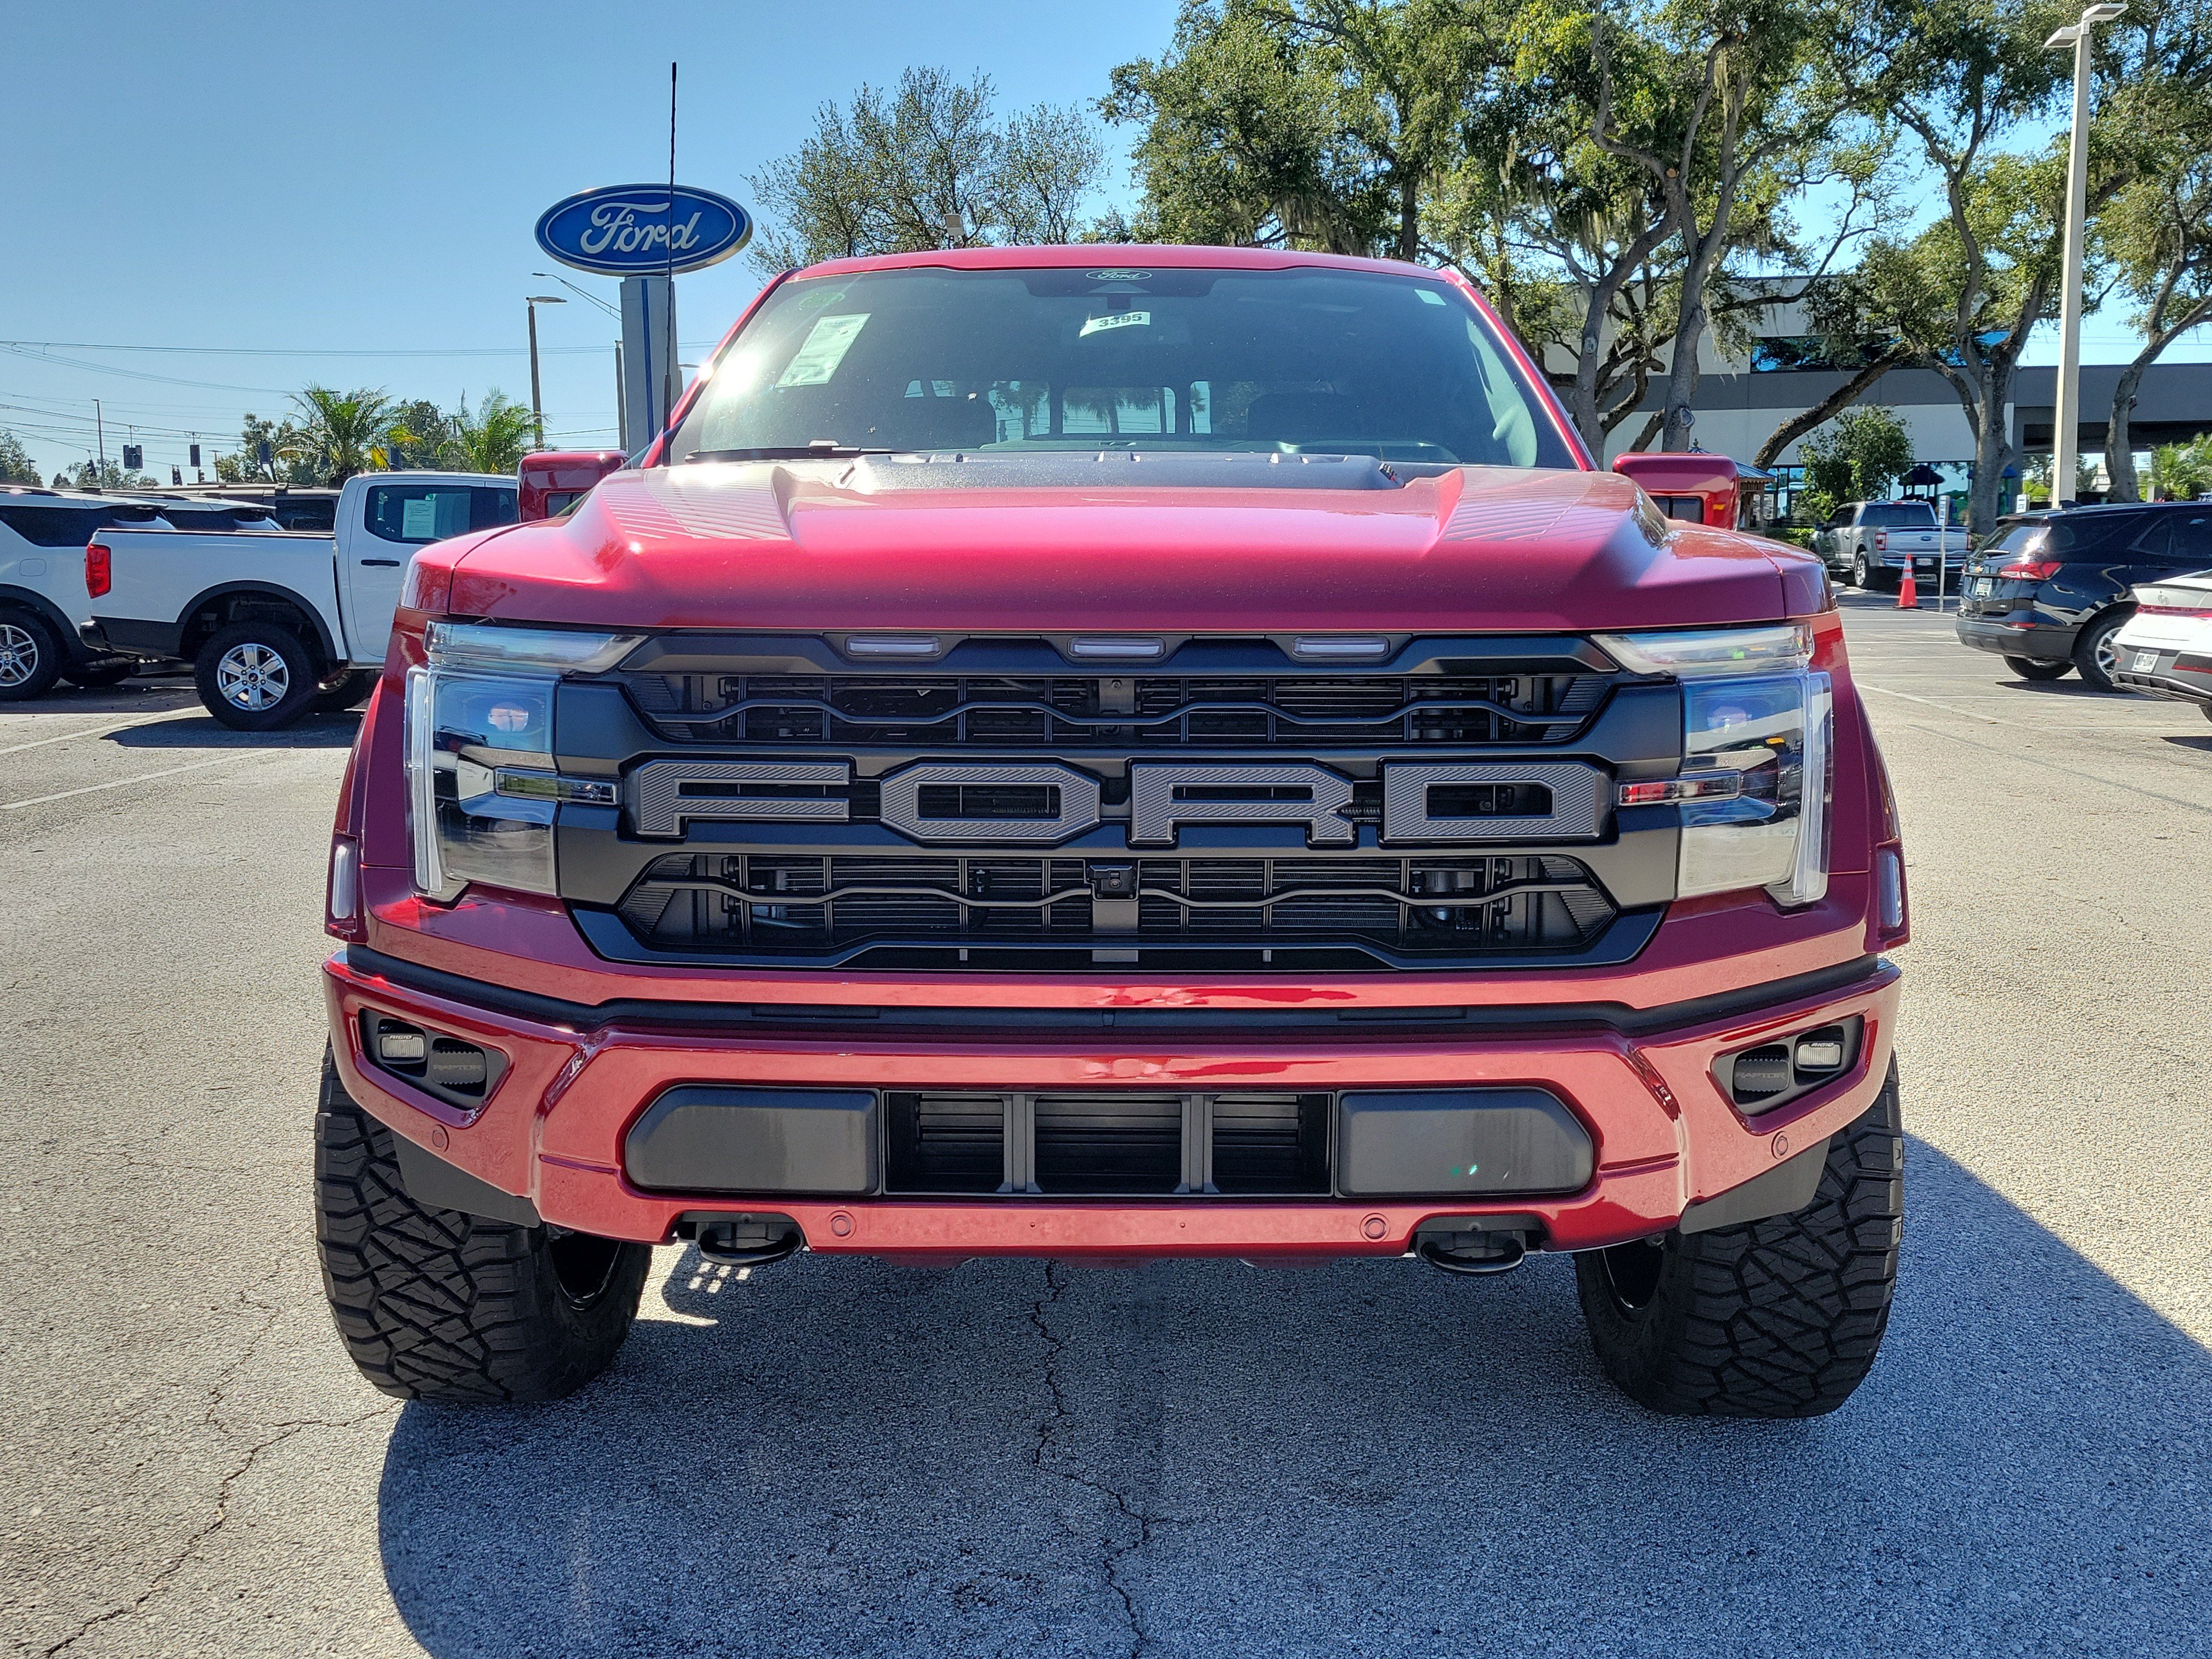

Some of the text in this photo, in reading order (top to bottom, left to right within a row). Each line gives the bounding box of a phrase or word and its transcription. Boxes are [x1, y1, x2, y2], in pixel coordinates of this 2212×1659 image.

[580, 202, 702, 254] Ford
[1097, 270, 1141, 279] Ford
[1099, 313, 1142, 327] 3395
[630, 759, 1611, 845] FORD
